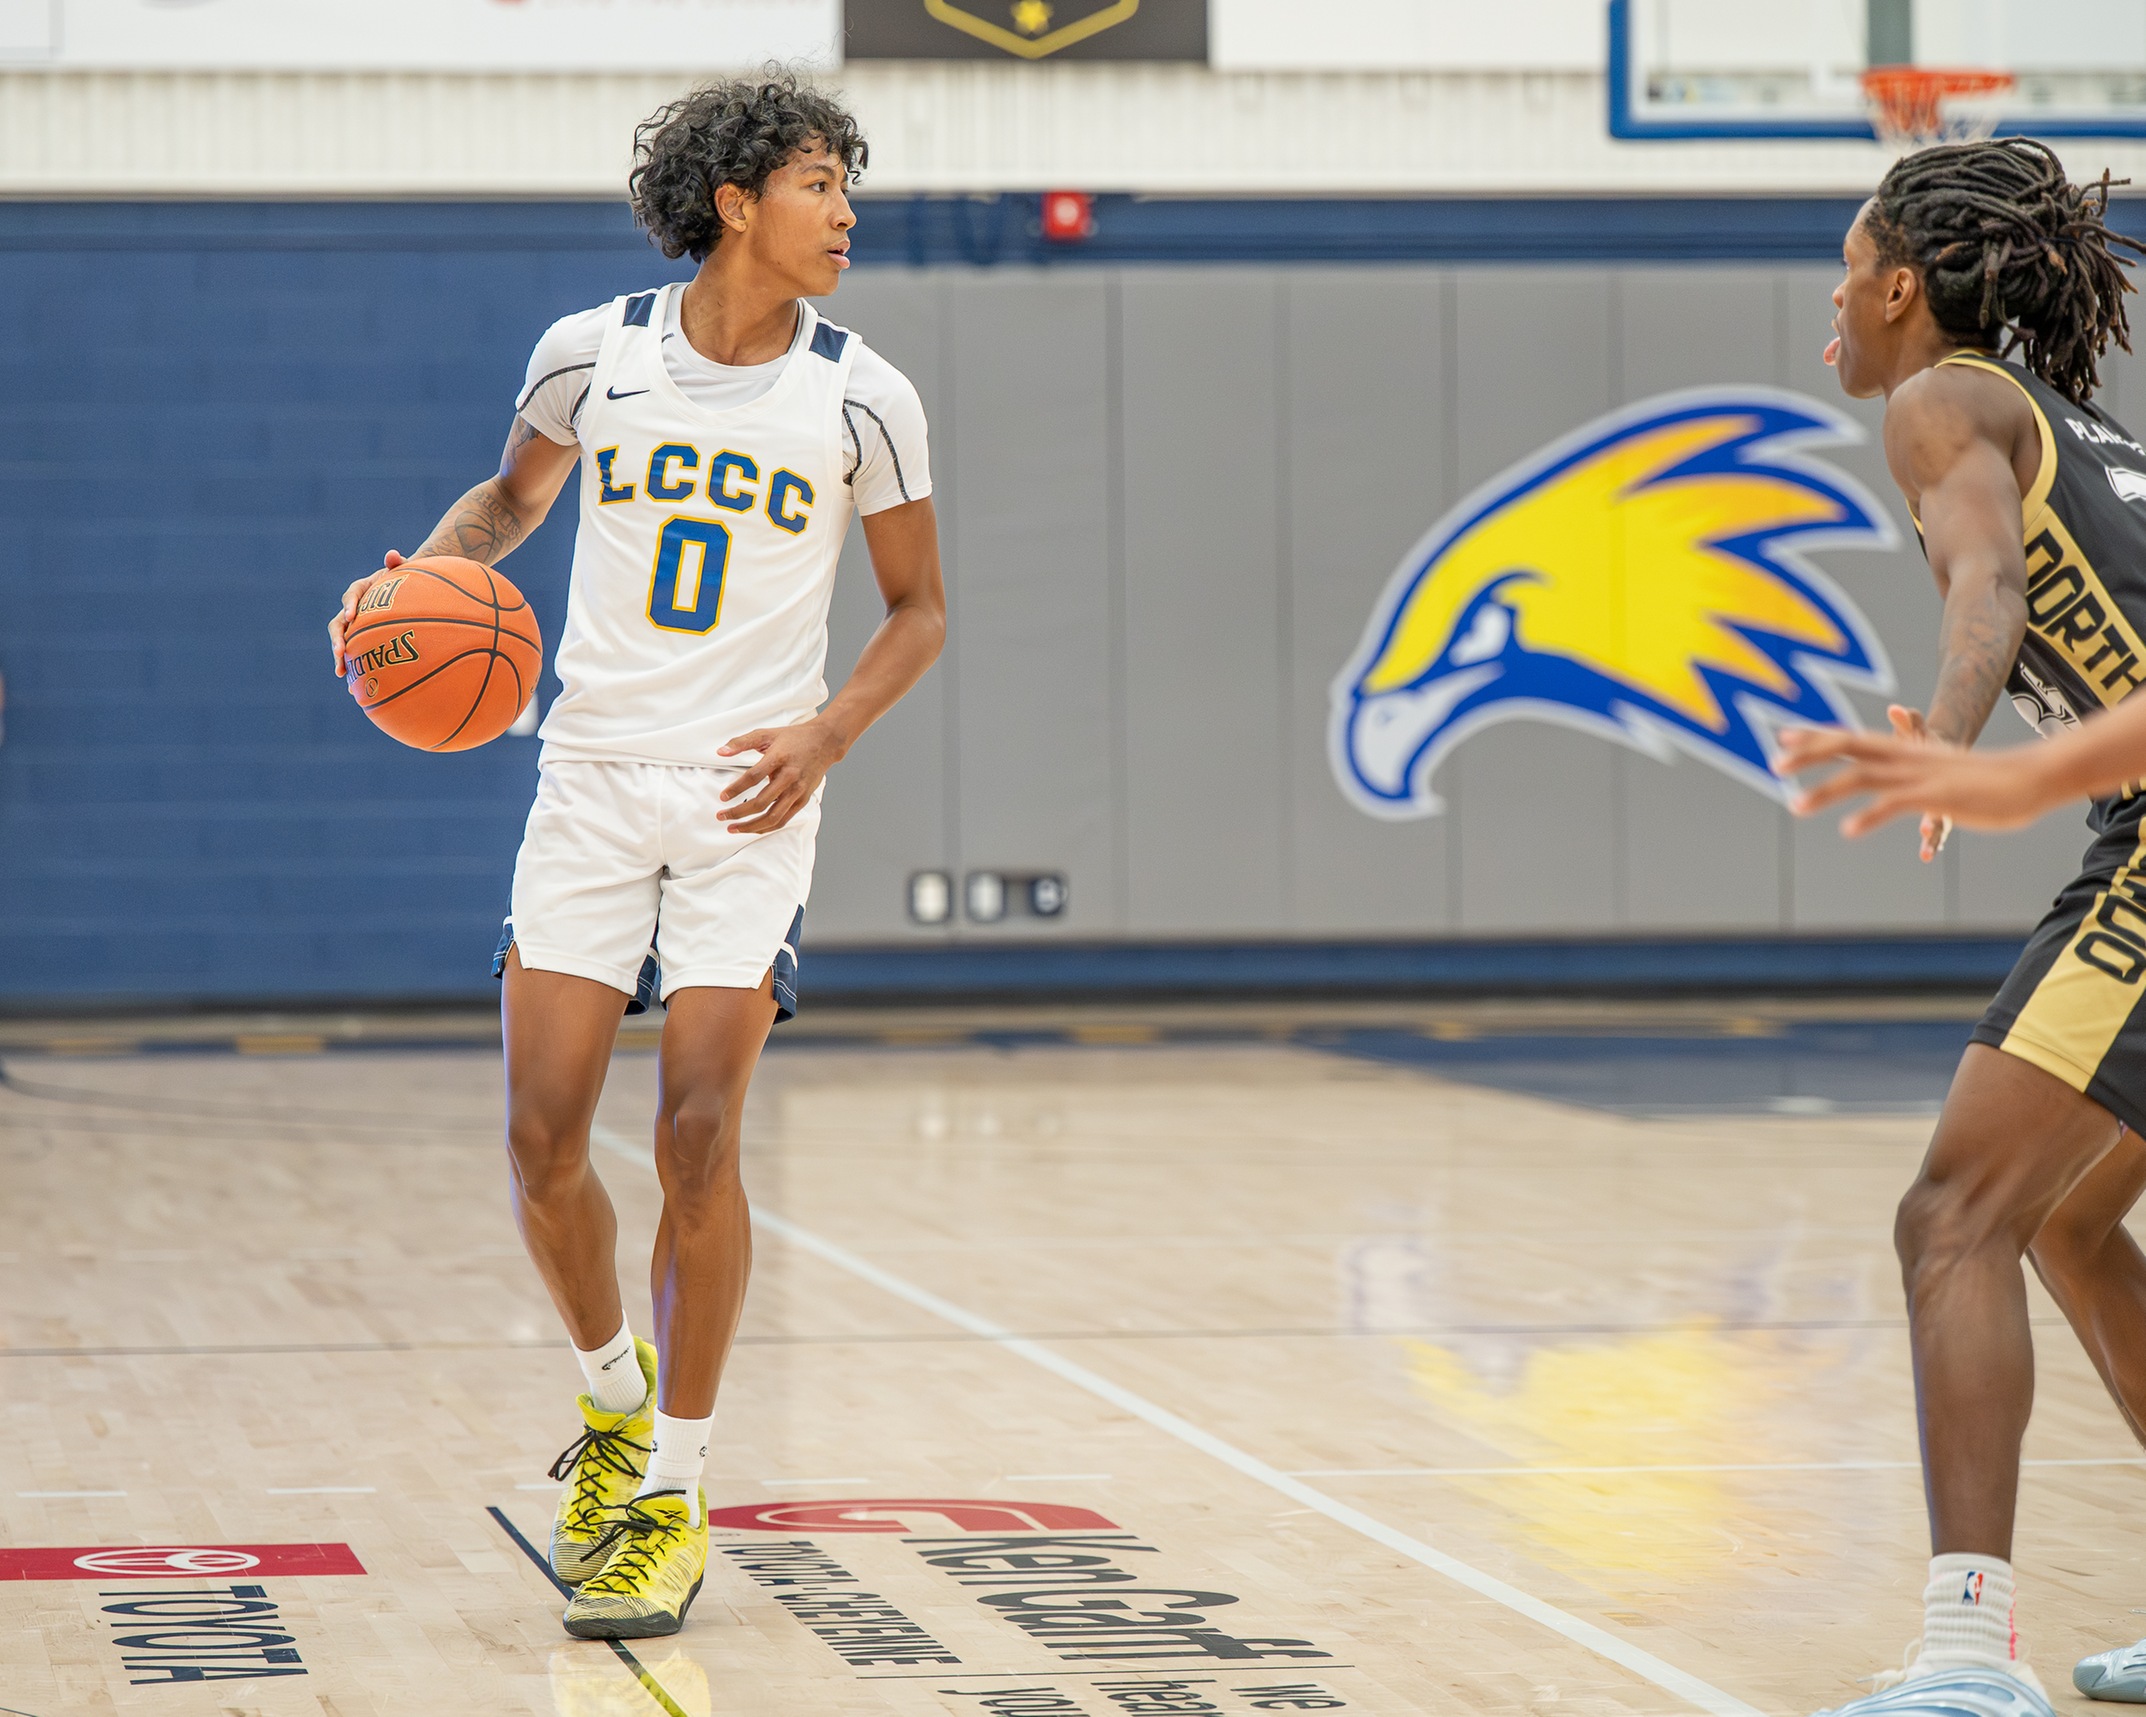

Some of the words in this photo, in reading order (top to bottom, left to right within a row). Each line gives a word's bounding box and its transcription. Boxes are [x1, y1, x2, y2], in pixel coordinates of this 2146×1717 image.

[595, 441, 816, 536] LCCC
[645, 514, 733, 636] 0
[347, 629, 420, 685] SPALDI
[715, 1541, 859, 1586] TOYOTA
[900, 1535, 1161, 1585] Ken
[99, 1585, 309, 1685] TOYOTA
[773, 1592, 963, 1665] CHEYENNE
[976, 1588, 1334, 1661] Garff
[1230, 1684, 1346, 1710] we
